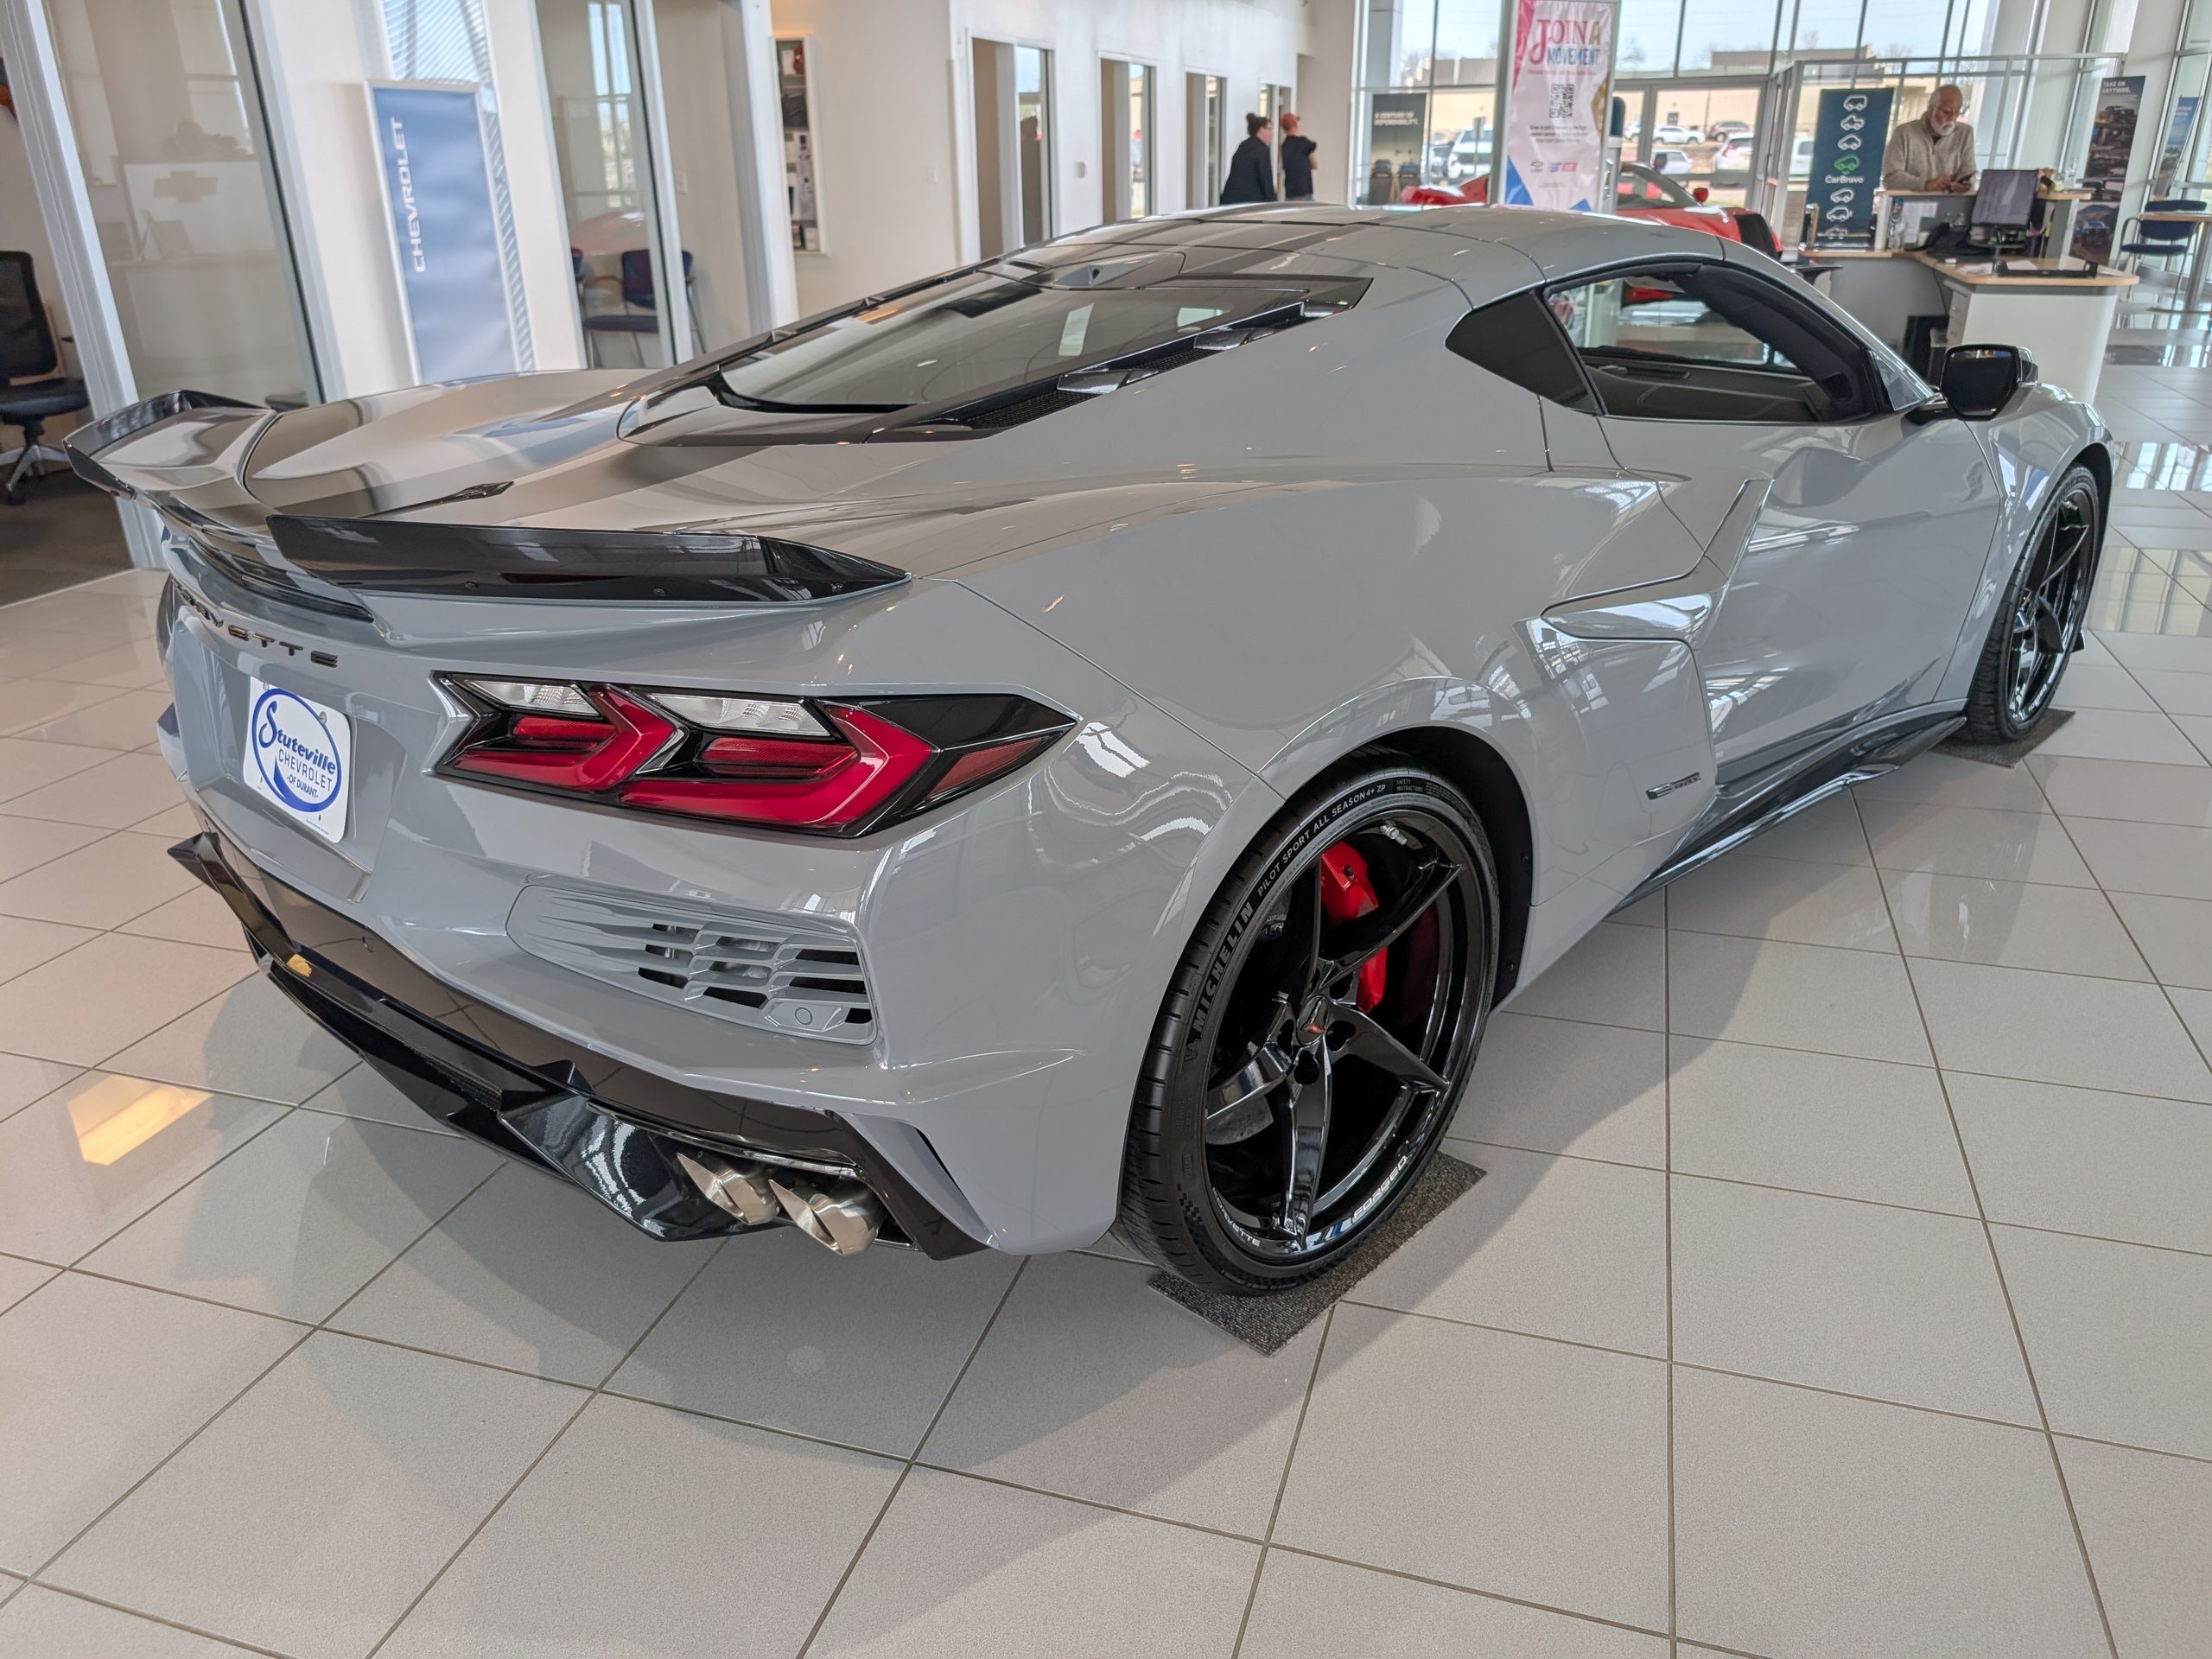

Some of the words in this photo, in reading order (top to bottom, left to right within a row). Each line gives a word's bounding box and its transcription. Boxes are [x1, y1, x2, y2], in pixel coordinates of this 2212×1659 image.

[1528, 18, 1589, 65] JOIN
[1589, 21, 1601, 45] A
[1547, 47, 1602, 66] MOVEMENT
[391, 116, 426, 273] CHEVROLET
[1824, 174, 1865, 184] CarBravo
[258, 700, 336, 775] Stuteville
[278, 748, 333, 792] CHEVROLET
[1257, 861, 1281, 897] PILOT
[1282, 830, 1311, 864] SPORT
[1313, 815, 1330, 834] ALL
[1332, 791, 1366, 817] SEASON
[1376, 784, 1386, 793] ZP
[1192, 901, 1254, 1034] MICHELIN
[1353, 1155, 1408, 1219] FORGED
